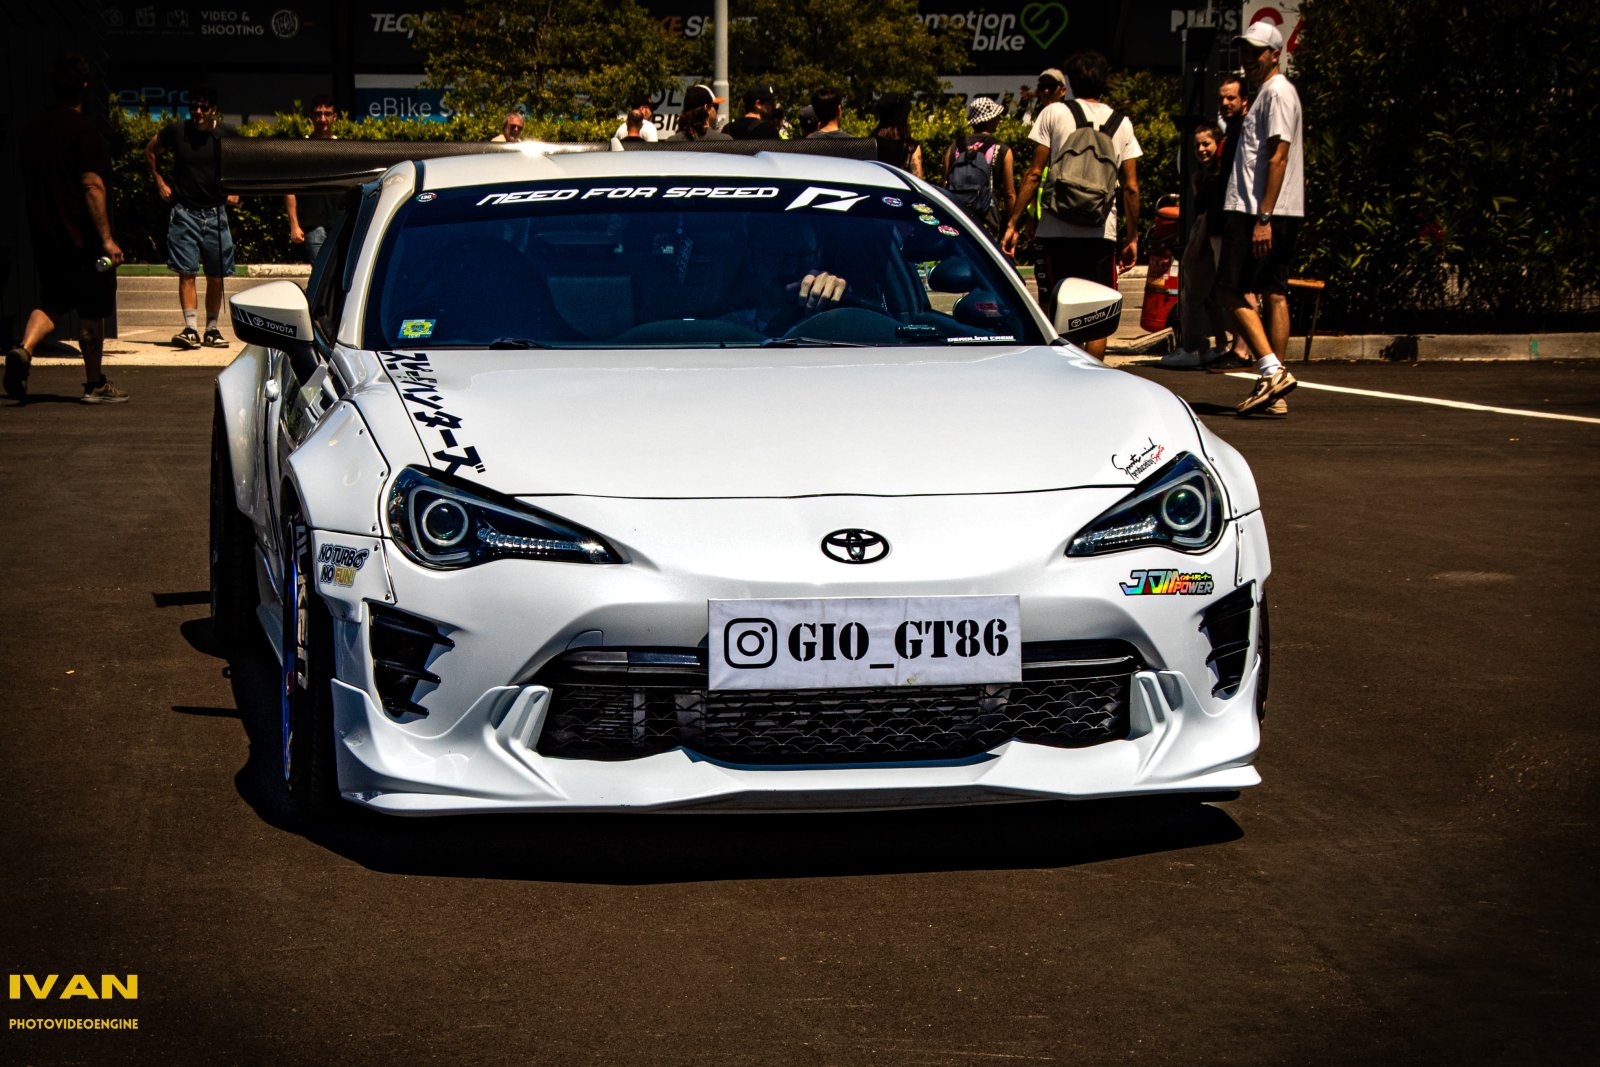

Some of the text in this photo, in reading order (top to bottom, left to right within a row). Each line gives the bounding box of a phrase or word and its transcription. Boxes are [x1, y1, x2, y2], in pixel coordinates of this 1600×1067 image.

[201, 10, 250, 22] VIDEO &
[200, 24, 264, 36] SHOOTING
[972, 29, 1026, 51] bike
[368, 97, 433, 117] eBike
[476, 186, 780, 206] NEED FOR SPEED
[1083, 311, 1106, 324] TOYOTA
[266, 321, 294, 335] TOYOTA
[319, 544, 333, 563] NO
[320, 565, 335, 584] NO
[1120, 569, 1214, 595] JDM POWER
[296, 524, 309, 691] ALKEN
[788, 618, 1009, 669] GIO_GT86
